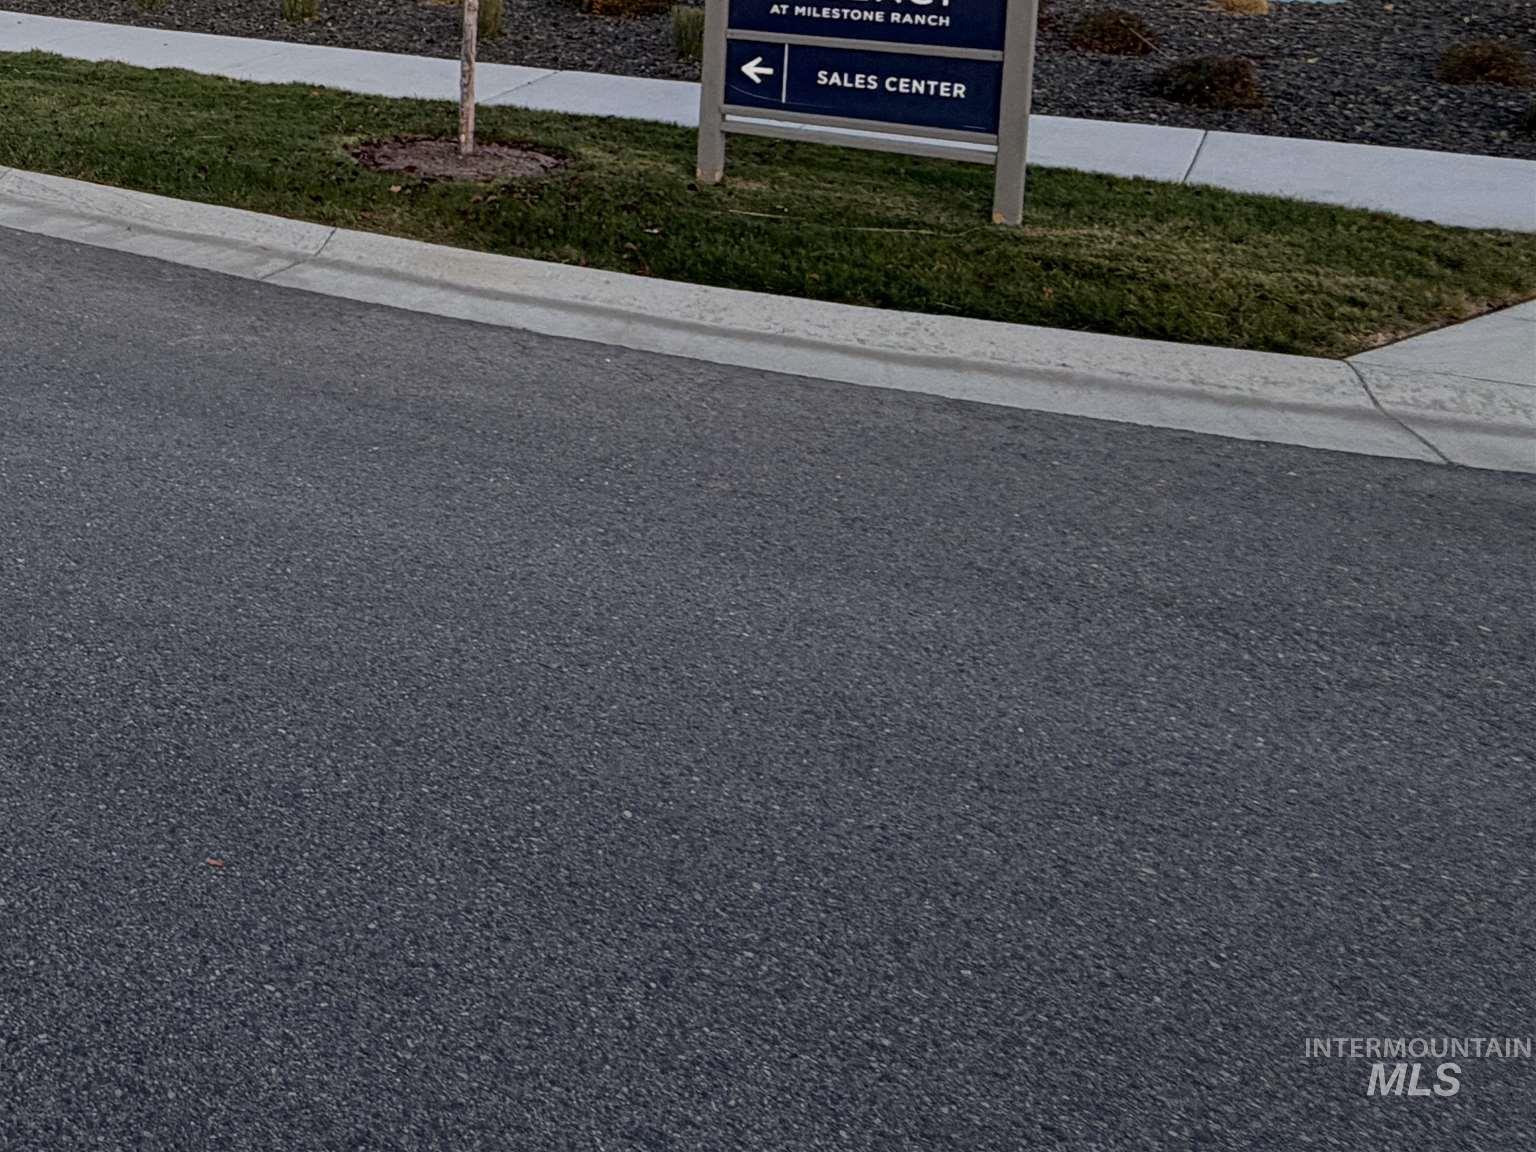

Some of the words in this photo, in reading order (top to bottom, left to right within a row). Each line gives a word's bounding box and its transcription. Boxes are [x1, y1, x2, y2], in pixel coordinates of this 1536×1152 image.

[769, 4, 790, 15] AT
[794, 5, 885, 23] MILESTONE
[890, 12, 951, 27] RANCH
[816, 70, 878, 90] SALES
[884, 77, 966, 98] CENTER
